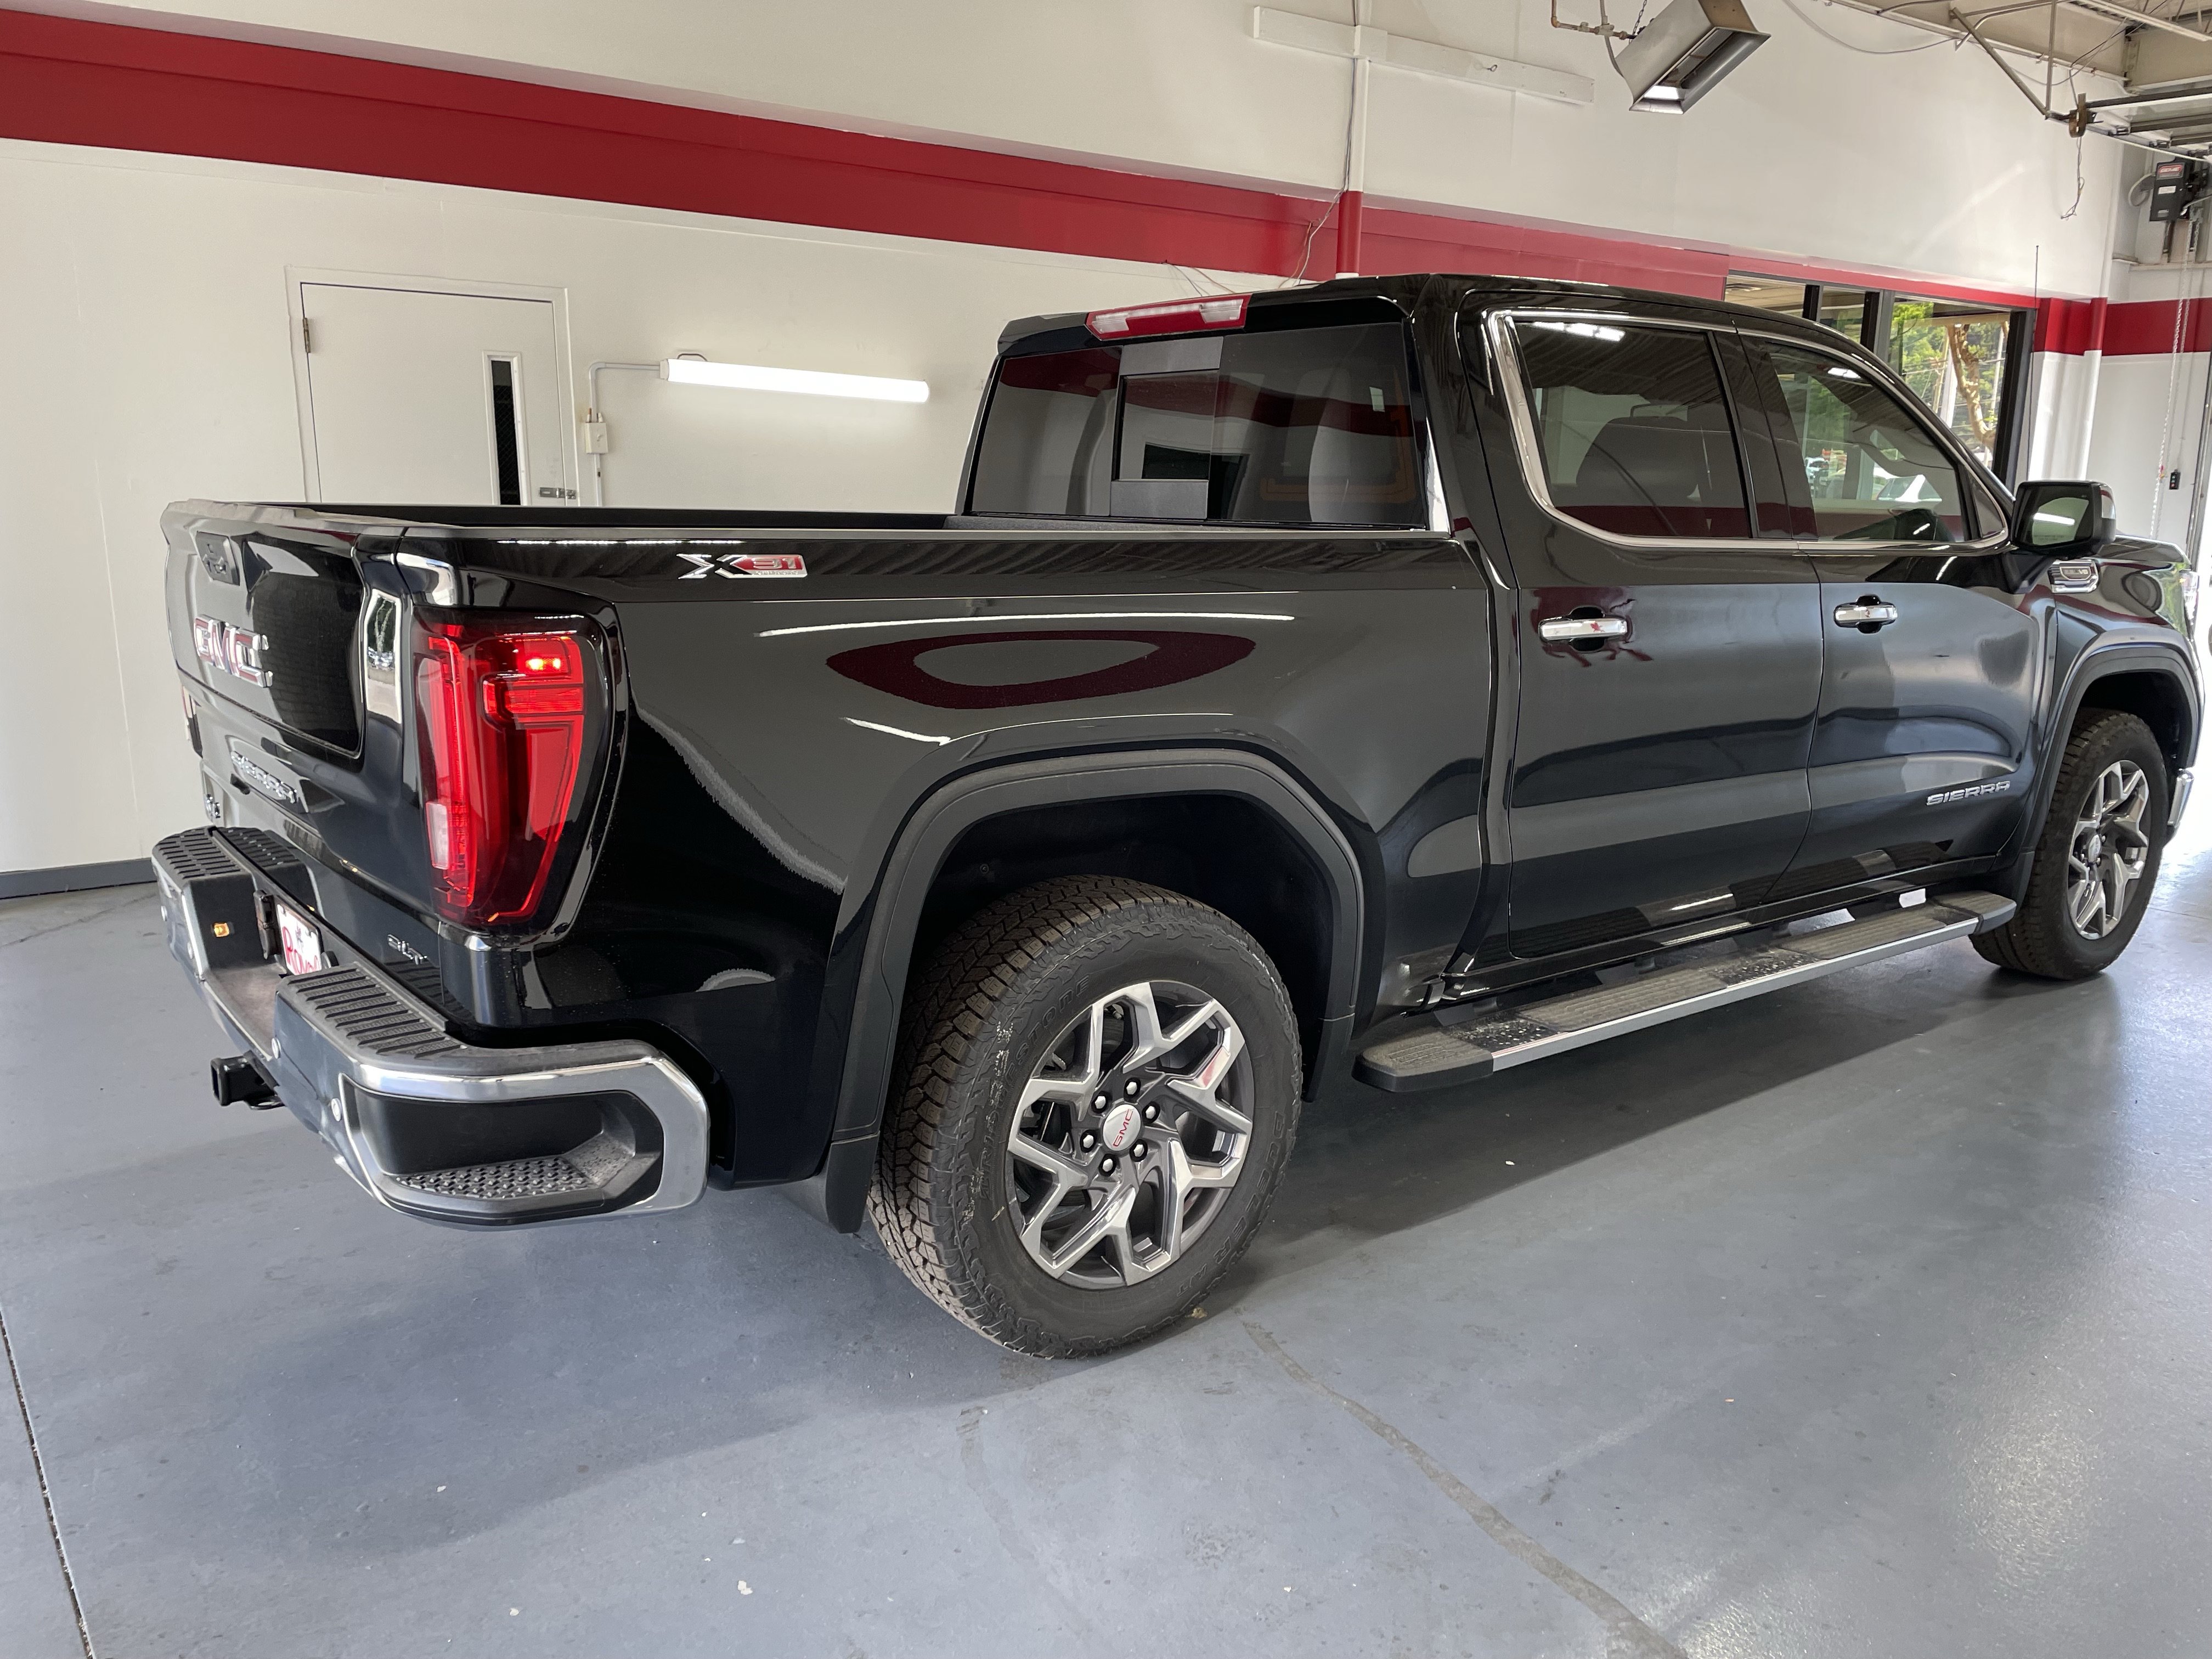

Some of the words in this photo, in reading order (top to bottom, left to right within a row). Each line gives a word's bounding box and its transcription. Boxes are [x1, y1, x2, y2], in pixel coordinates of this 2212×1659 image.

[194, 616, 273, 687] GMC
[231, 751, 298, 804] SIERRA
[1926, 780, 2011, 806] SIERRA
[387, 934, 428, 966] SLT
[1112, 1108, 1134, 1148] GMC
[1212, 1110, 1286, 1265] DUELER
